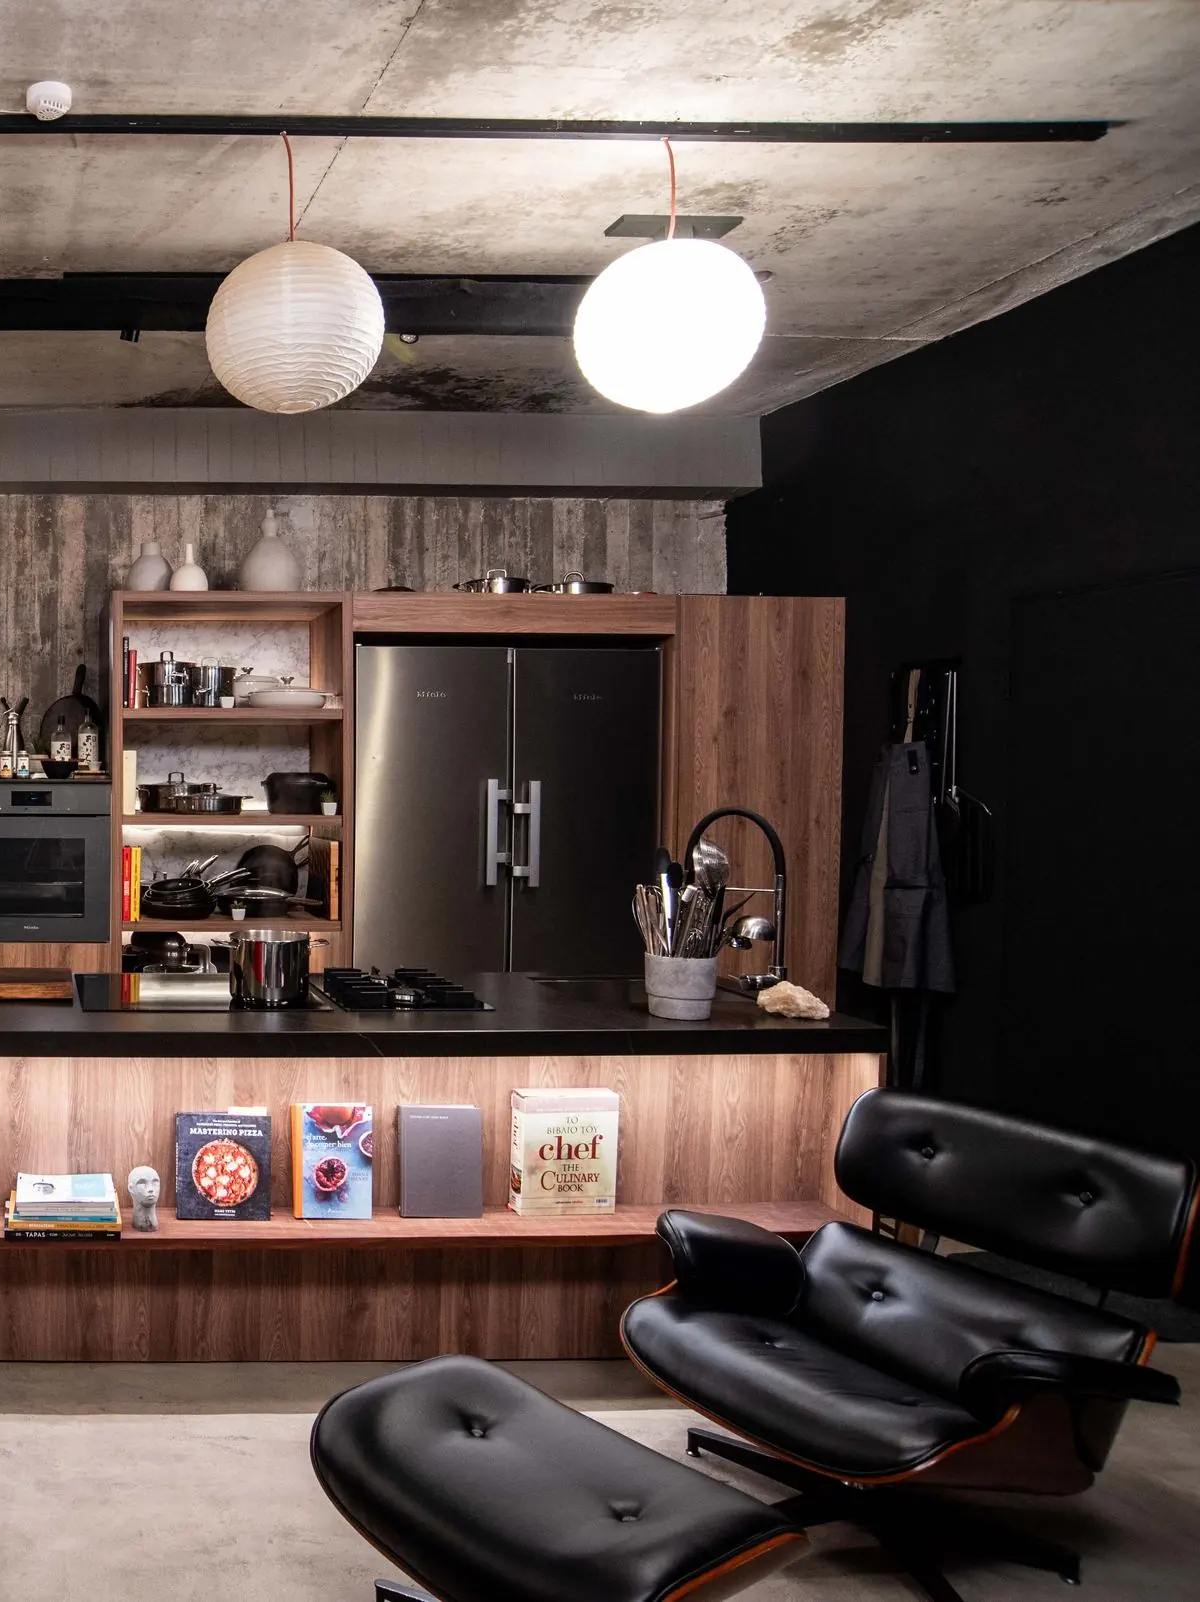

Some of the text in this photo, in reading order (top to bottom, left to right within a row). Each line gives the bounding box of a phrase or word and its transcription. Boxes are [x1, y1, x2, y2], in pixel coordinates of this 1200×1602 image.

[189, 1127, 264, 1137] MASTERING PIZZA
[538, 1134, 604, 1161] chef
[562, 1164, 580, 1172] THE
[540, 1170, 600, 1191] CULINARY
[557, 1184, 584, 1192] BOOK
